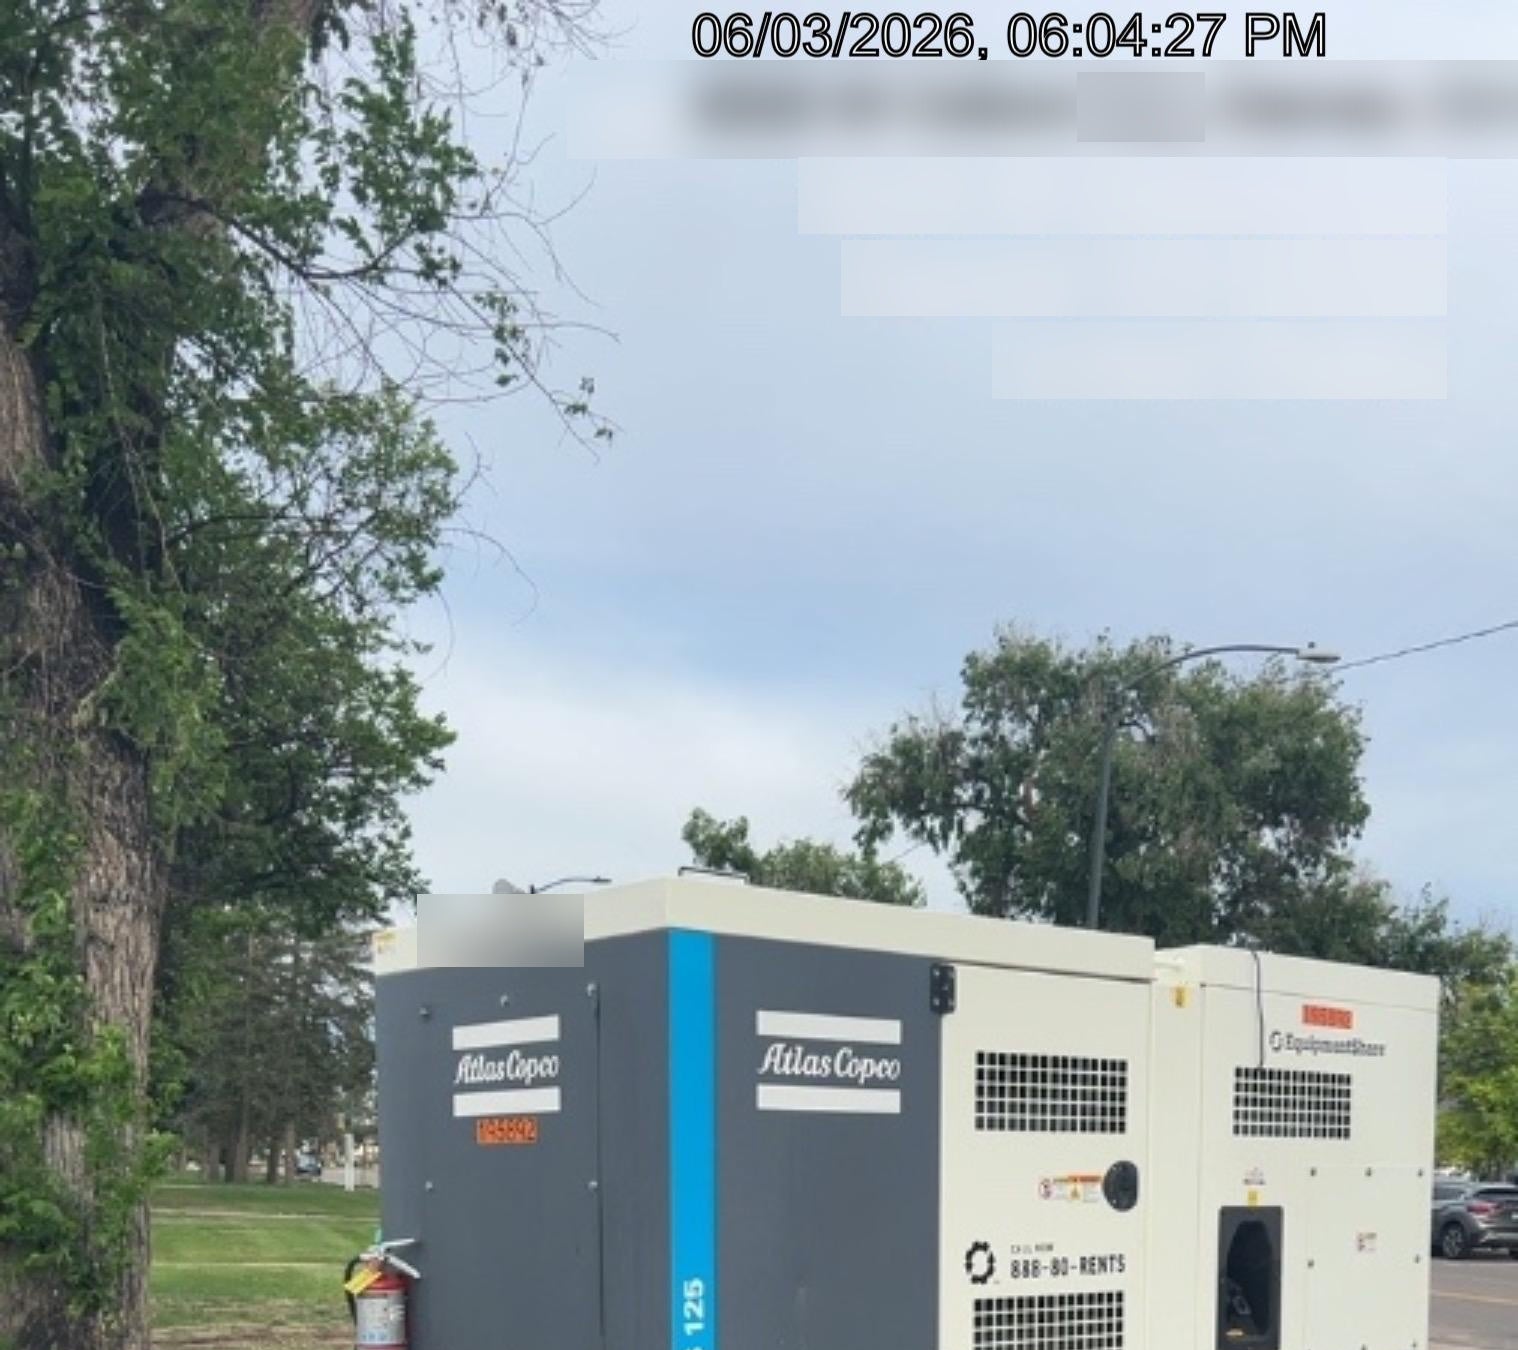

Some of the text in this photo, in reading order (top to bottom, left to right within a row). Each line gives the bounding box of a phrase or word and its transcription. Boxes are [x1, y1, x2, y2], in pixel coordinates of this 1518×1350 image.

[453, 1049, 559, 1086] Atlas Copco
[757, 1042, 901, 1085] Atlas Copco
[683, 1277, 705, 1336] 125
